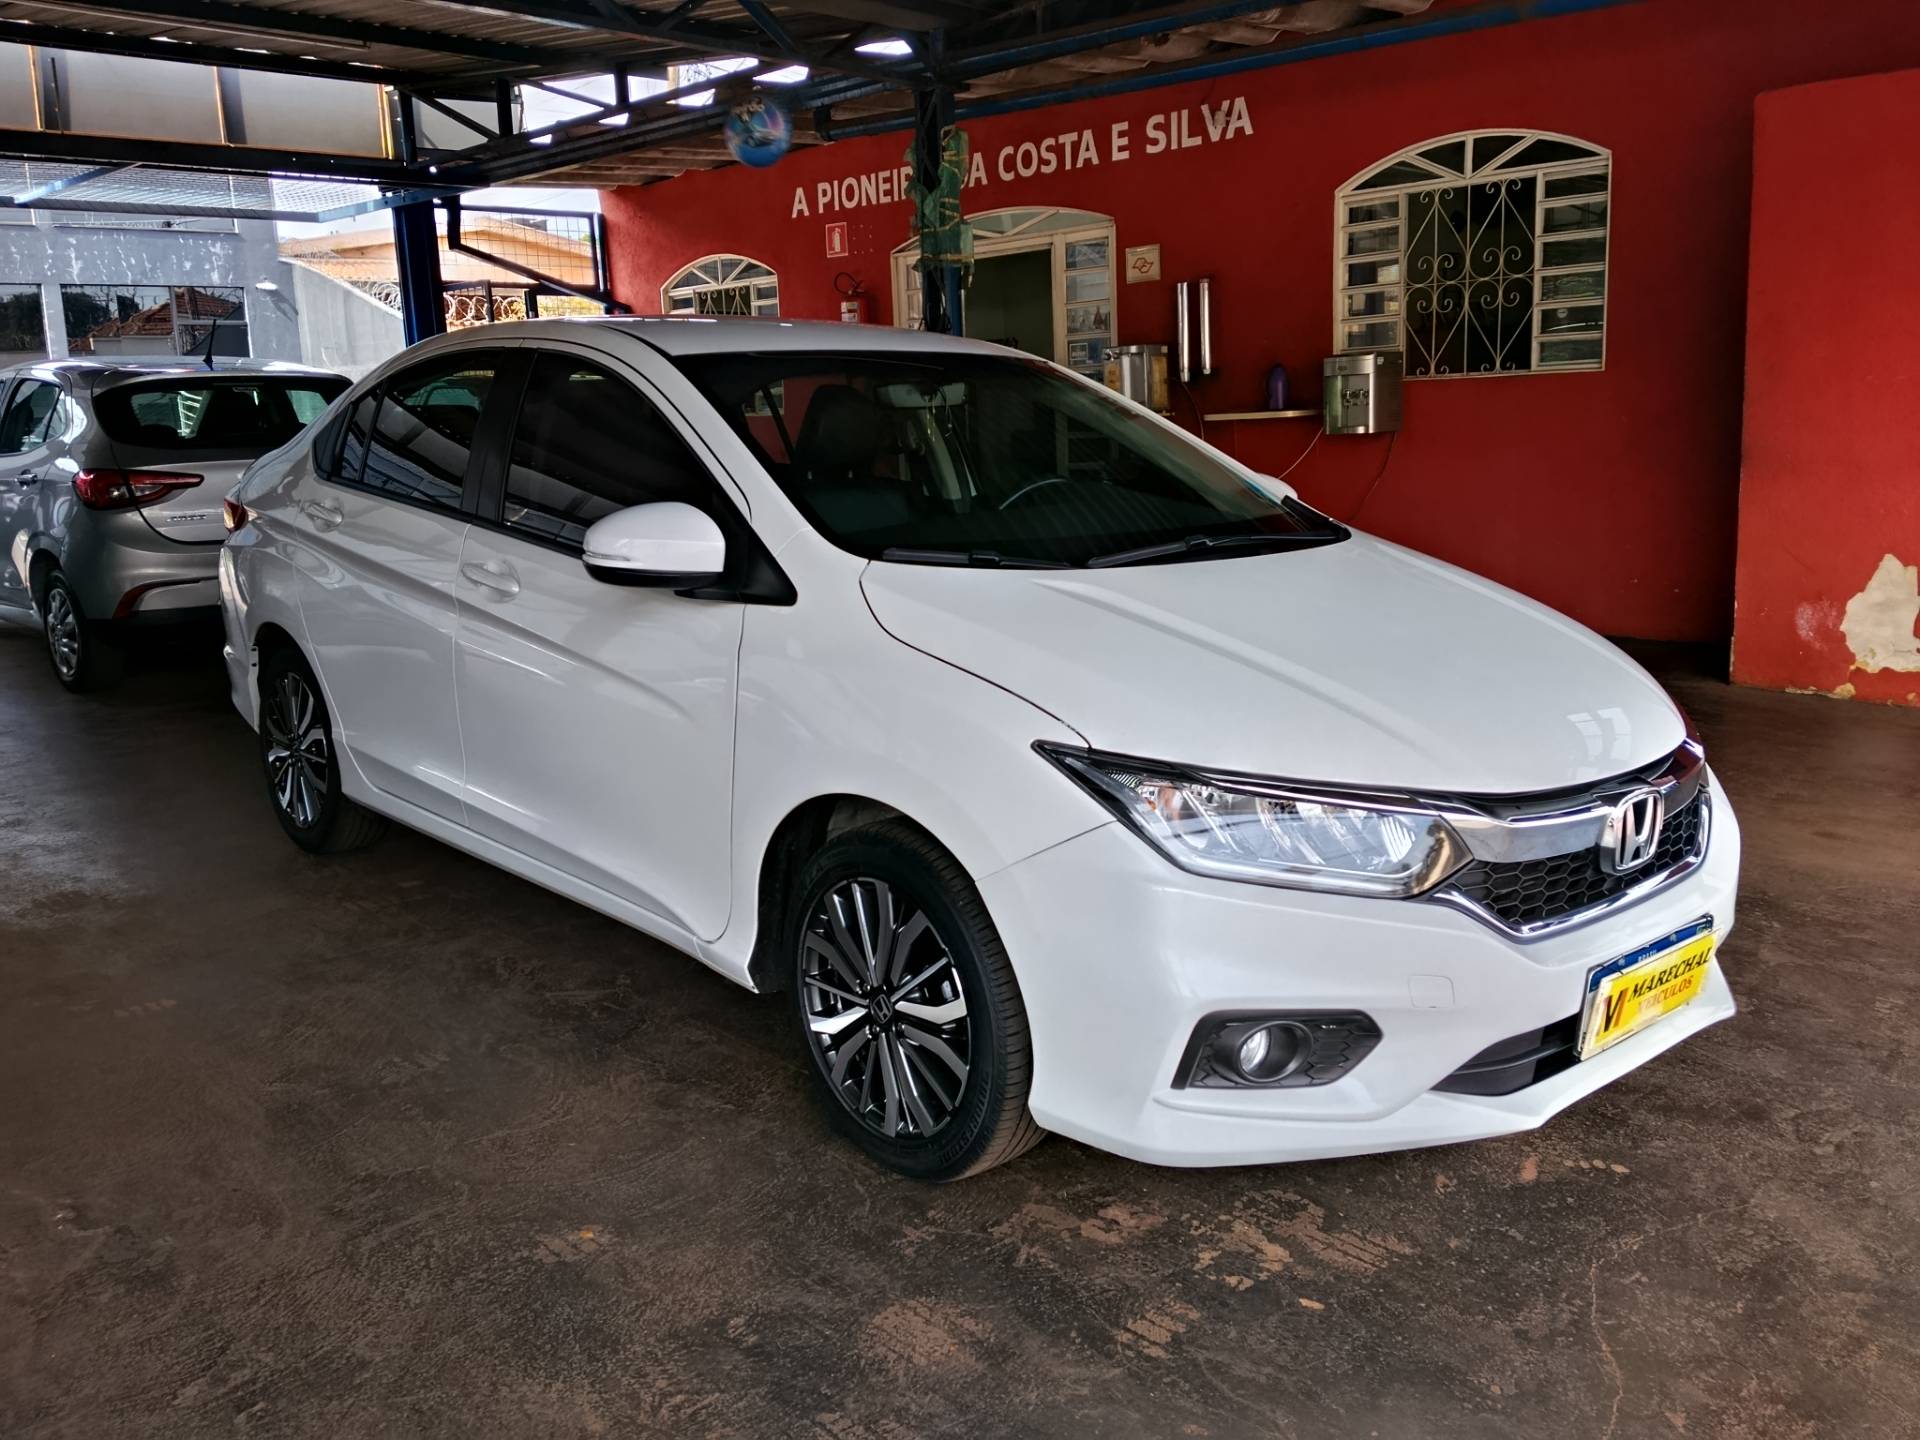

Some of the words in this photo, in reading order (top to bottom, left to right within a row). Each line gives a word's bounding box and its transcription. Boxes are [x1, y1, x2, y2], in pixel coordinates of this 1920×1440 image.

[791, 187, 810, 219] A
[817, 166, 914, 214] PIONEIR
[959, 152, 988, 189] A
[998, 129, 1100, 181] COSTA
[1111, 120, 1130, 162] E
[1145, 96, 1254, 154] SILVA
[1631, 947, 1712, 998] MARECHAL
